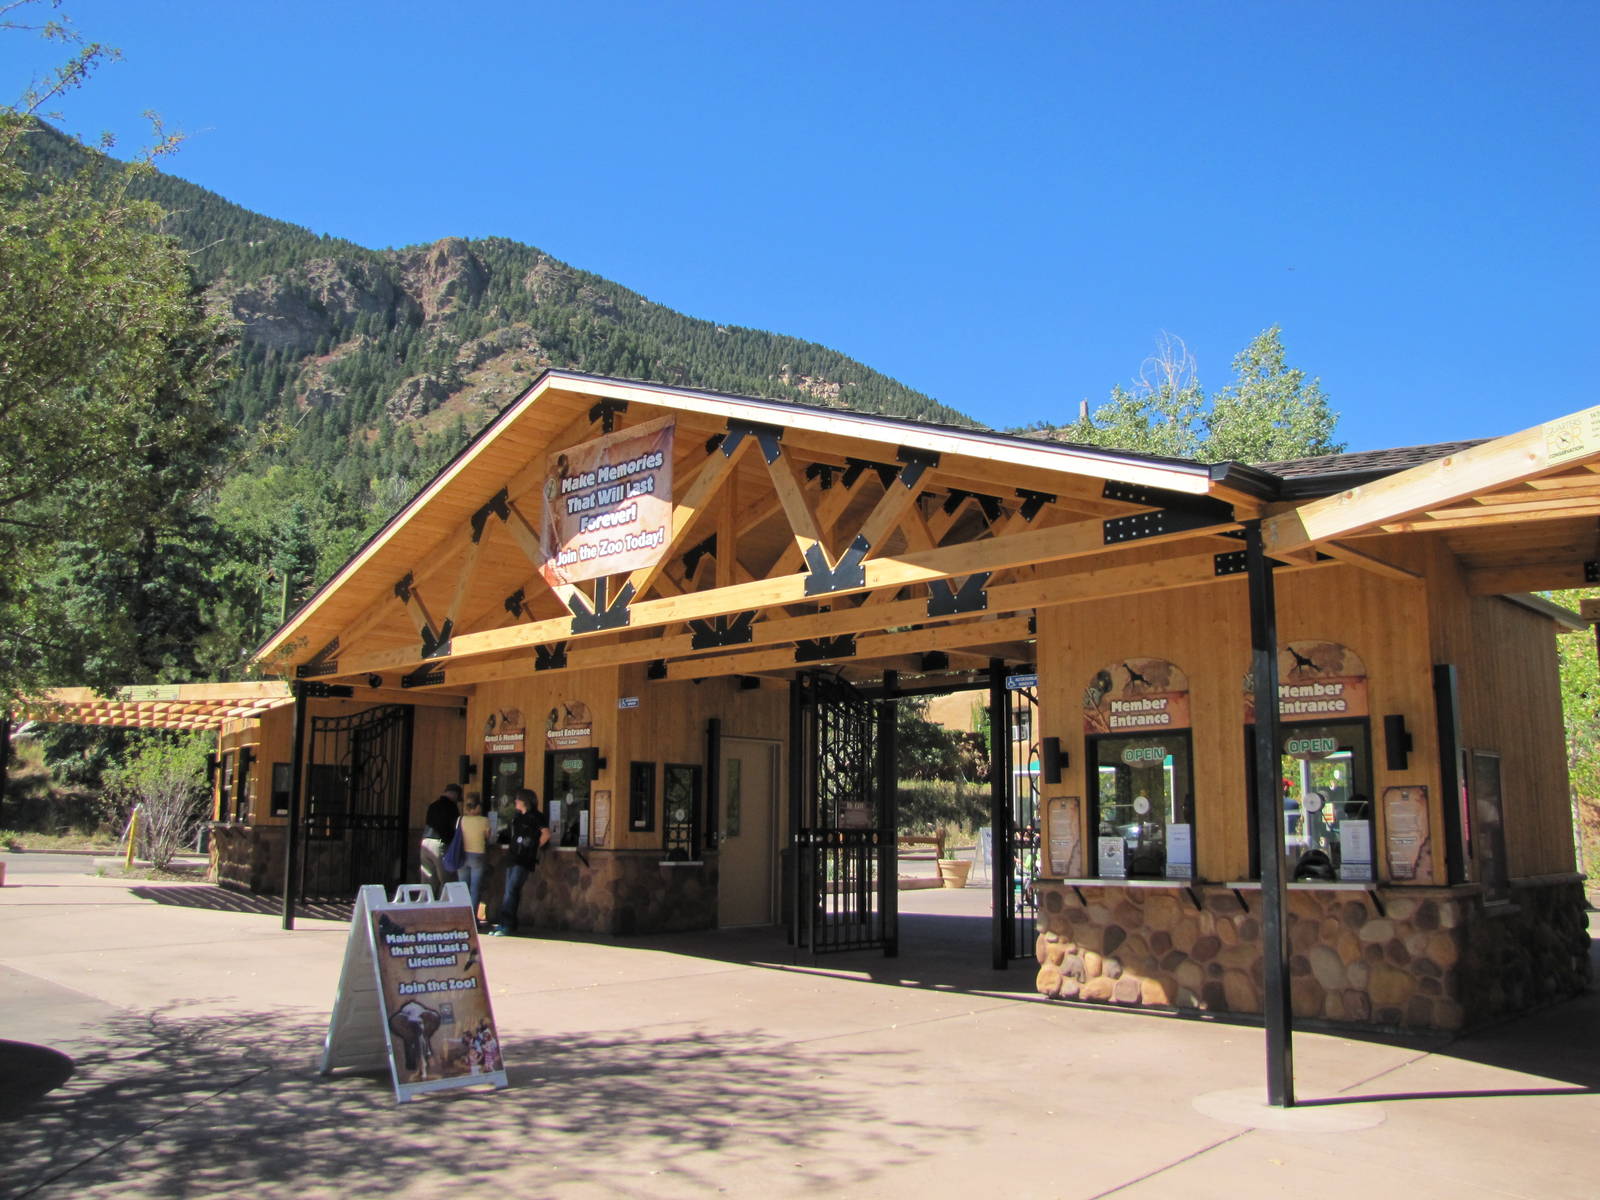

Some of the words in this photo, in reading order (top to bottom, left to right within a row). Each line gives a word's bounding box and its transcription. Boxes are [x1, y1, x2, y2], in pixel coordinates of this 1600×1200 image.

[562, 472, 595, 493] Make
[598, 452, 663, 483] Memories
[568, 493, 595, 513] That
[598, 484, 624, 505] Will
[627, 476, 653, 498] Last
[580, 504, 637, 532] Forever!
[557, 548, 577, 566] Join
[580, 544, 597, 560] the
[600, 541, 622, 555] Zoo
[625, 527, 664, 548] Today!
[1278, 683, 1343, 698] Member
[1111, 698, 1167, 712] Member
[1279, 700, 1345, 713] Entrance
[1110, 713, 1169, 727] Entrance
[548, 730, 563, 738] Guest
[564, 728, 590, 737] Entrance
[1288, 738, 1334, 753] OPEN
[1125, 747, 1165, 761] OPEN
[386, 933, 416, 944] Make
[417, 930, 469, 941] Memories
[391, 946, 414, 956] that
[415, 944, 437, 954] Will
[439, 943, 460, 952] Last
[462, 943, 469, 951] a
[408, 955, 456, 968] Lifetime!
[400, 982, 426, 994] Join
[427, 981, 447, 991] the
[448, 978, 476, 989] Zoo!
